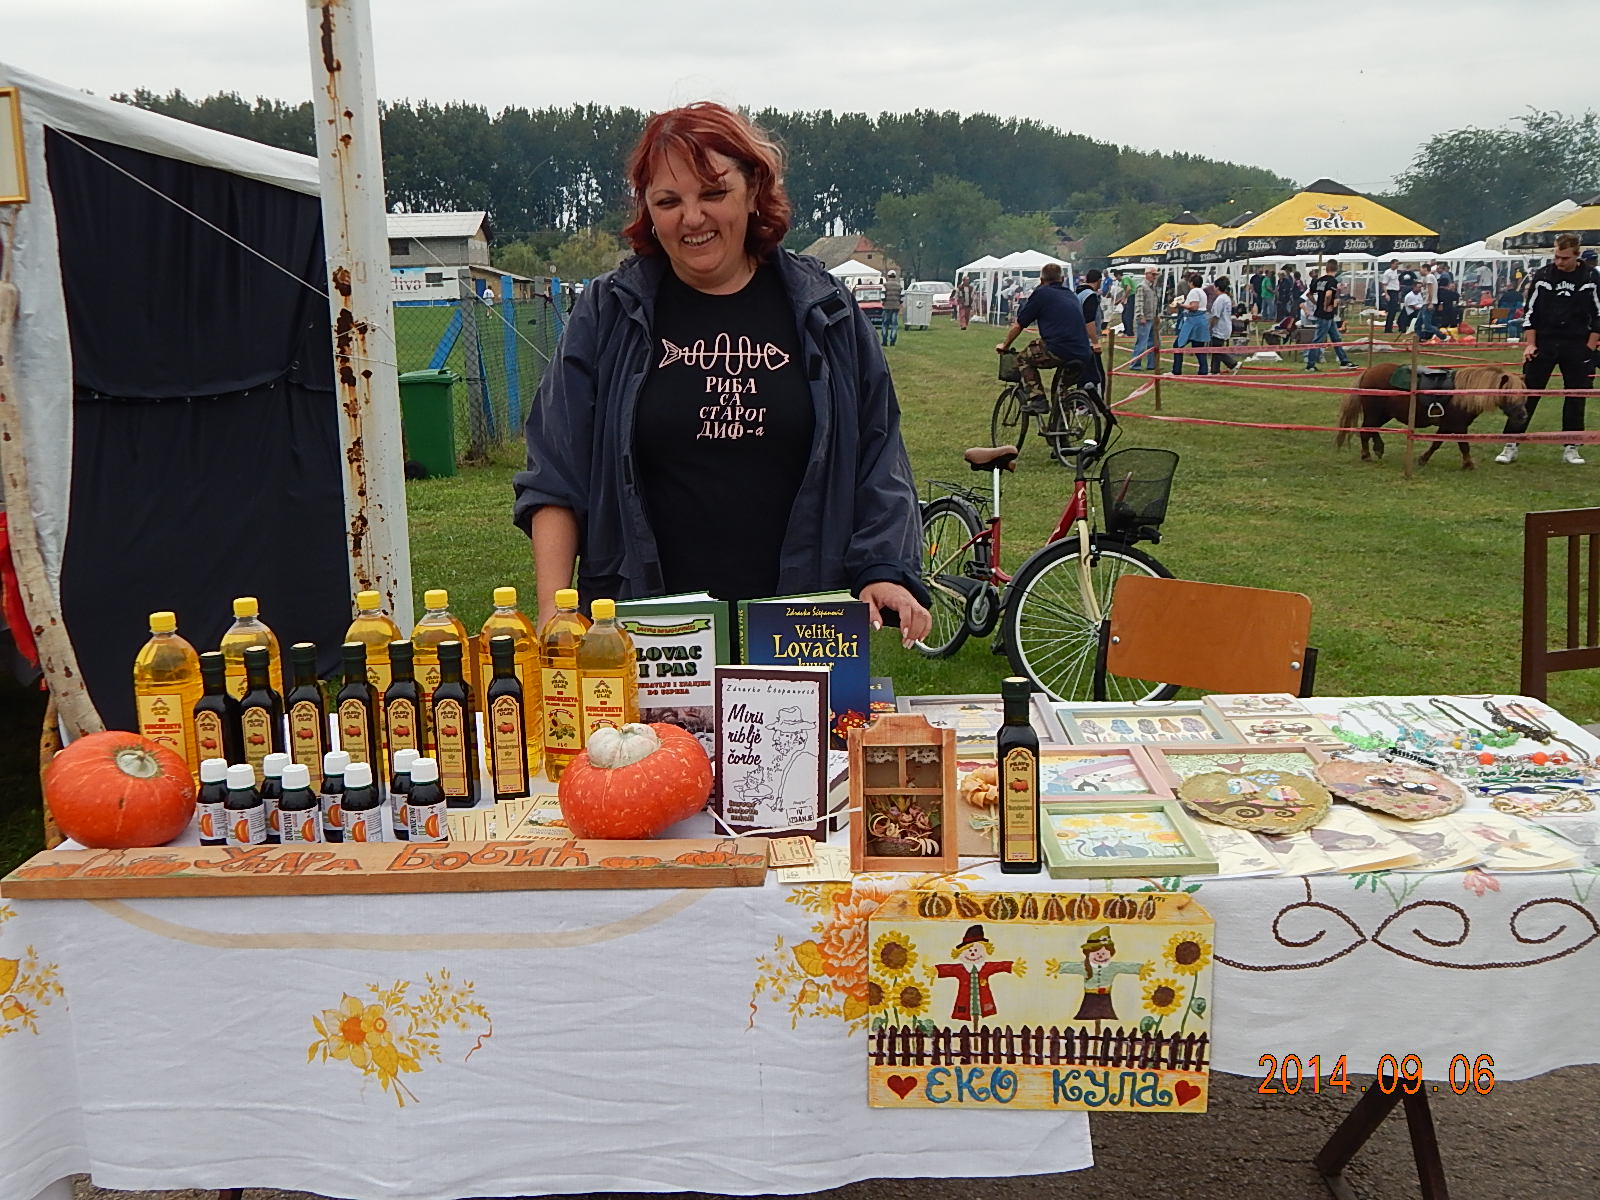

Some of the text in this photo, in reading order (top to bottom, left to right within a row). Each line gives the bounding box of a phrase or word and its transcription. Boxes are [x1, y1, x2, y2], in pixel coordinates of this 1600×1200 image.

[1305, 216, 1365, 230] Jelen
[705, 376, 758, 394] РИБА
[720, 392, 742, 406] СА
[700, 406, 766, 422] СТАРОГ
[794, 624, 836, 639] Veliki
[772, 633, 860, 658] Lovački
[636, 646, 702, 662] LOVAC
[639, 662, 698, 678] I PAS
[728, 704, 764, 724] Miris
[728, 748, 762, 765] čorbe
[386, 840, 590, 871] Бобић
